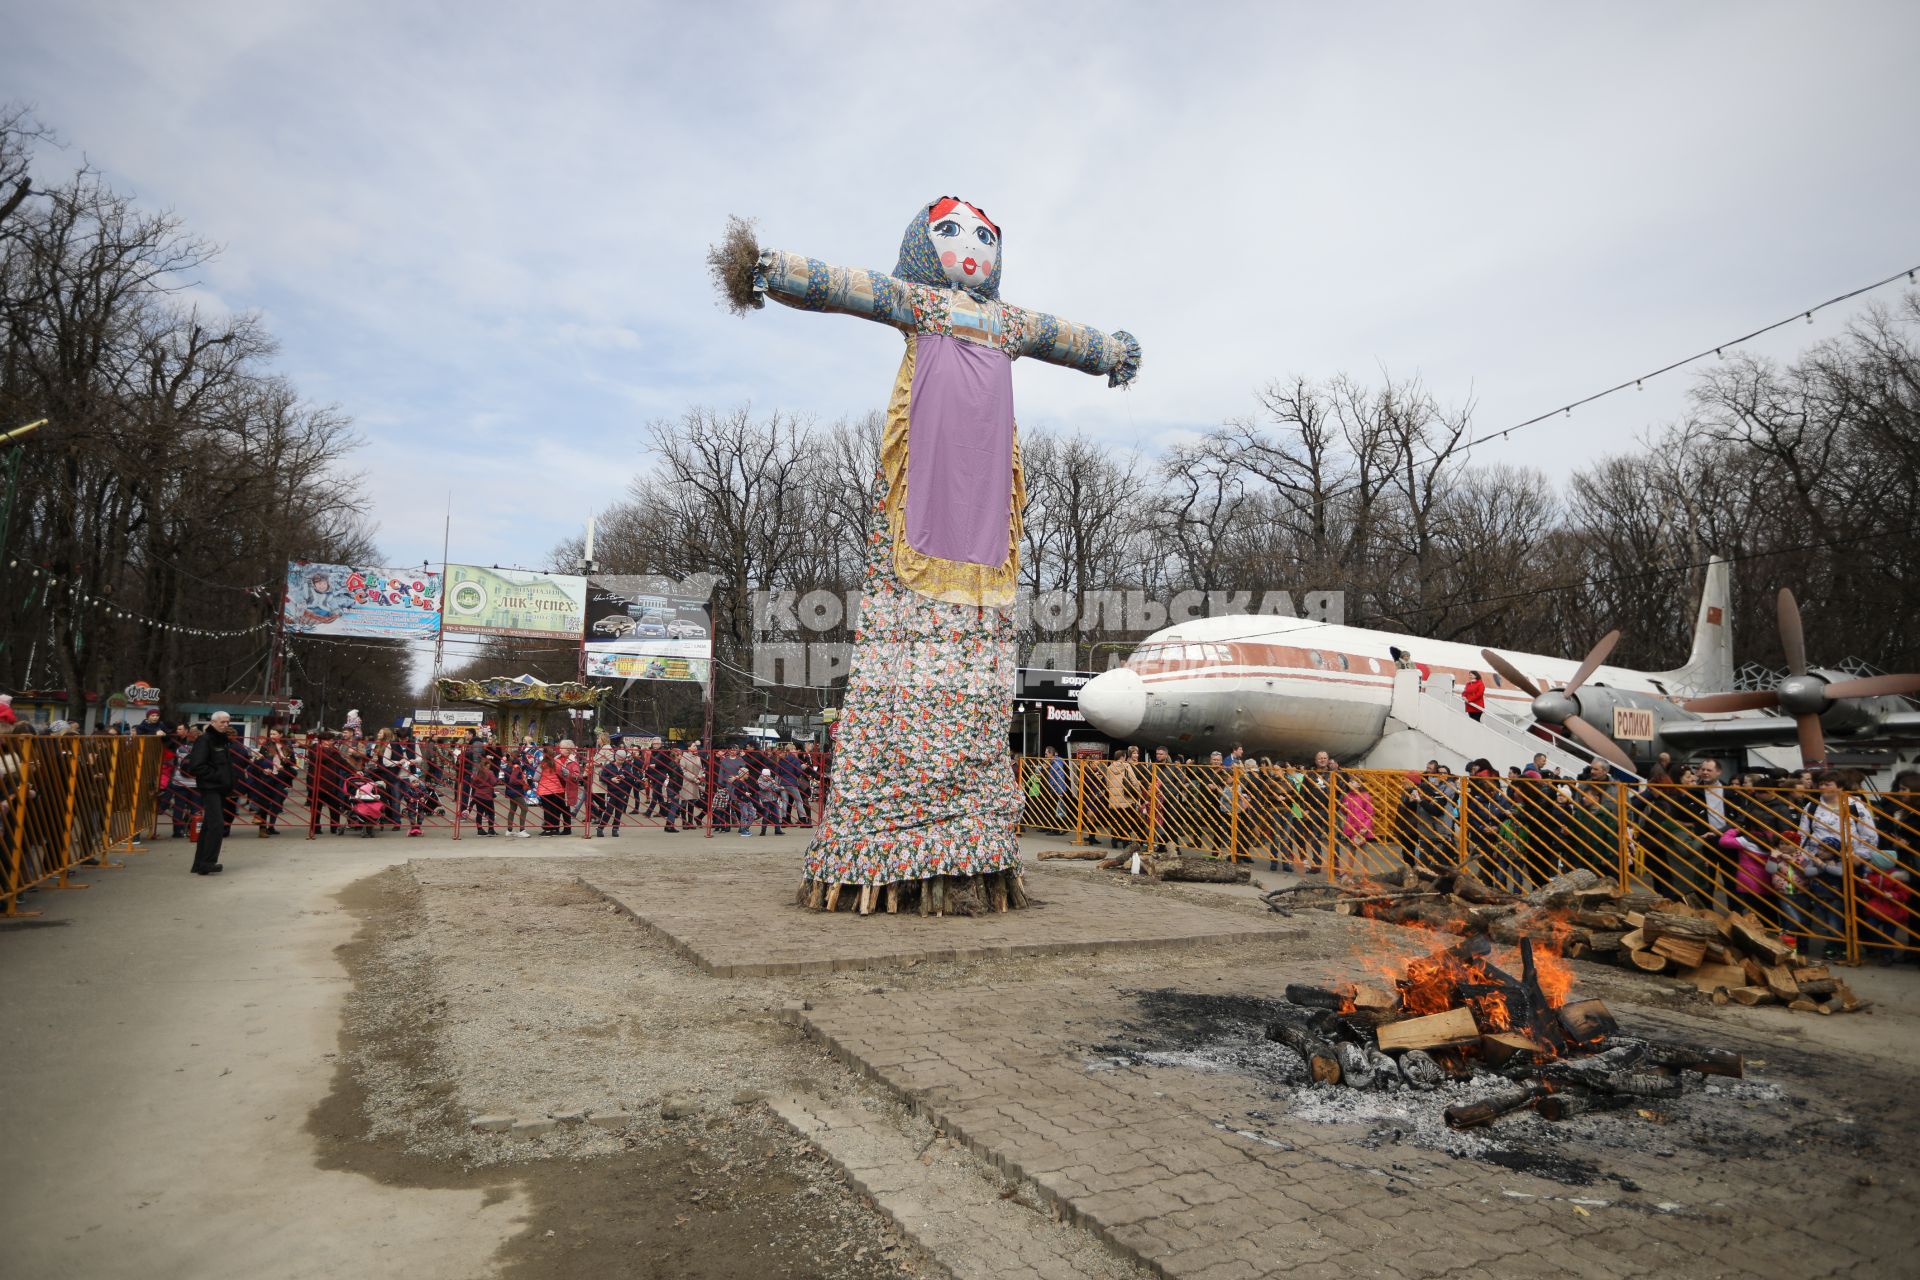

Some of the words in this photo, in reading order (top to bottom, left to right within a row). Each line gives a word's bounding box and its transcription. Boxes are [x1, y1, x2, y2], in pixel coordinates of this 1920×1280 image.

[346, 572, 436, 598] ДЕТСКОЕ
[355, 589, 434, 611] СЧАСТЬЕ
[1617, 711, 1650, 737] РОЛИКИ
